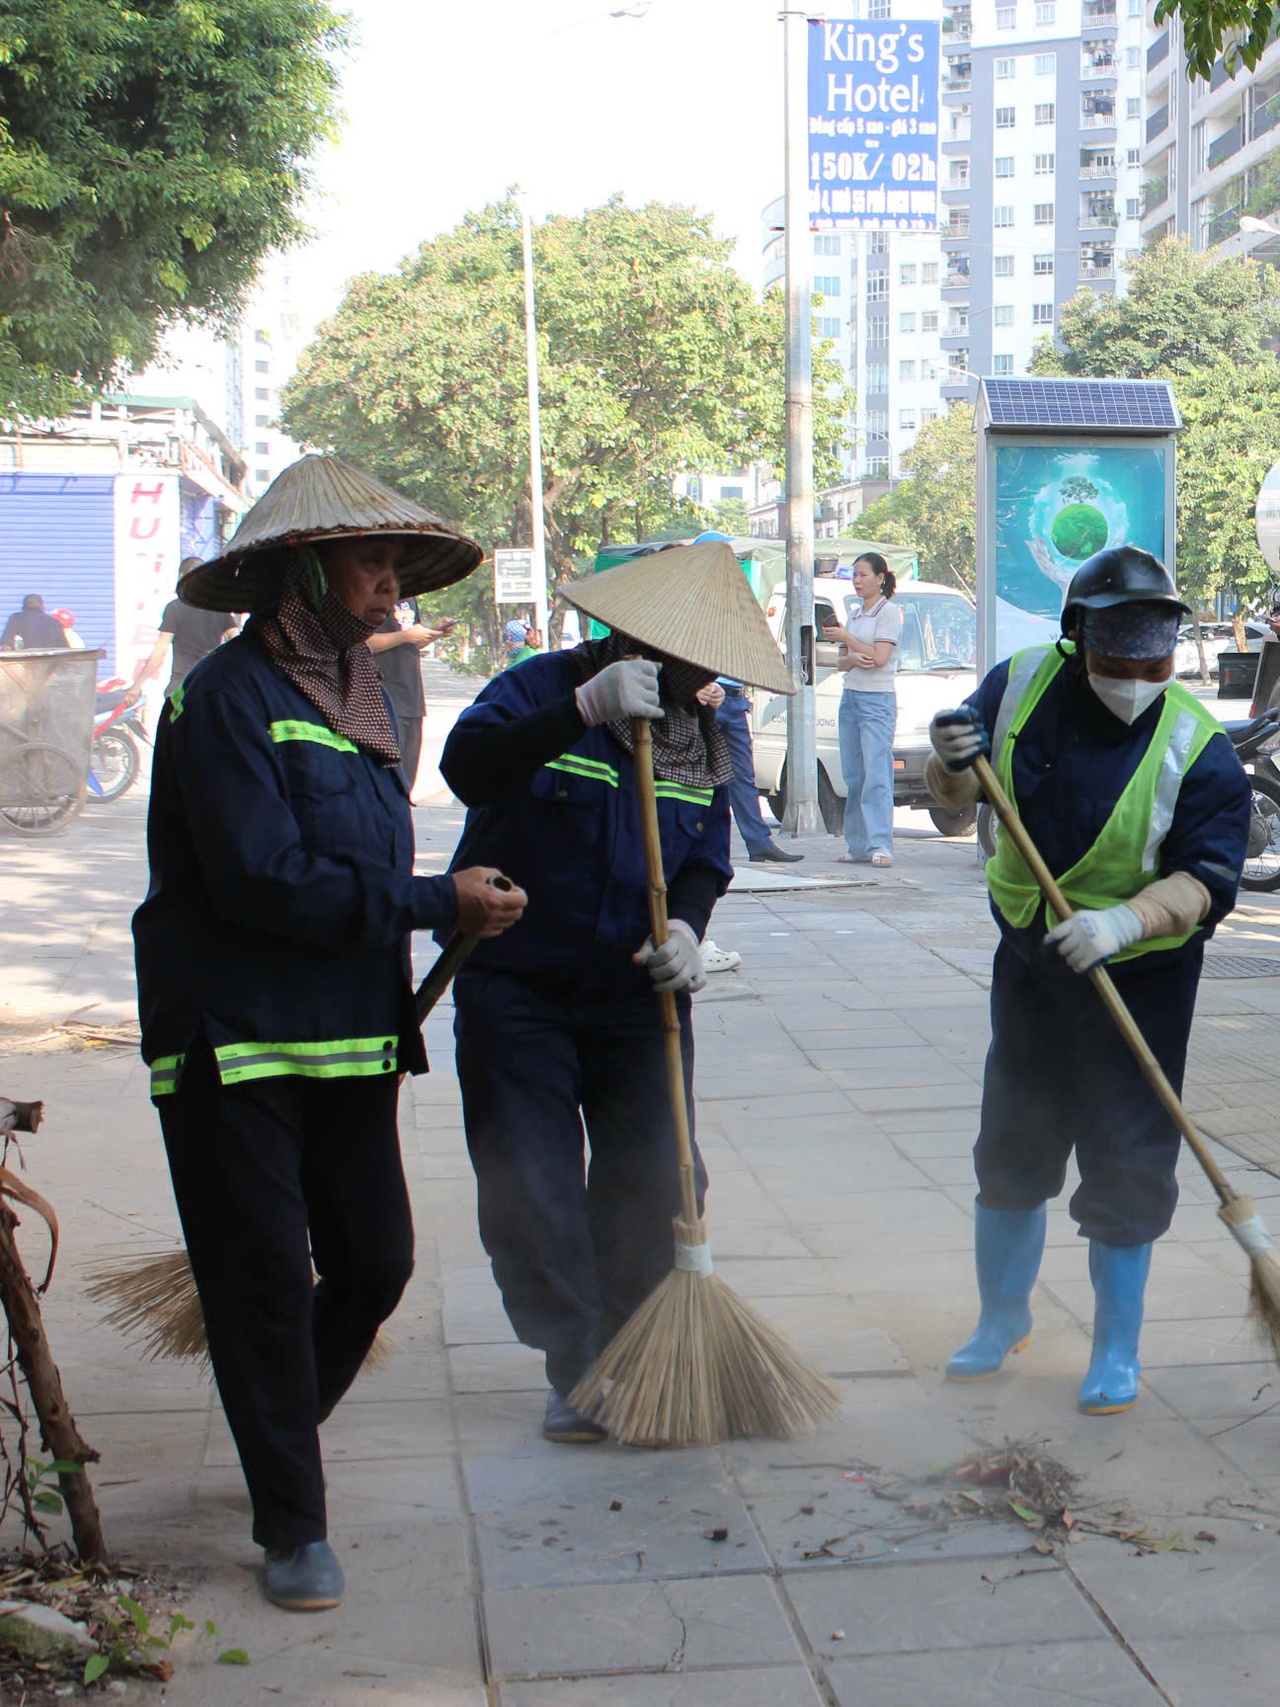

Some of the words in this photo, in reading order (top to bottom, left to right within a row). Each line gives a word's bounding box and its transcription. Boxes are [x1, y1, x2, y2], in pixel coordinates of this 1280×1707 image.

[823, 24, 925, 74] King's
[827, 74, 920, 113] Hotel
[811, 152, 885, 180] 150K/
[892, 152, 937, 181] 02h
